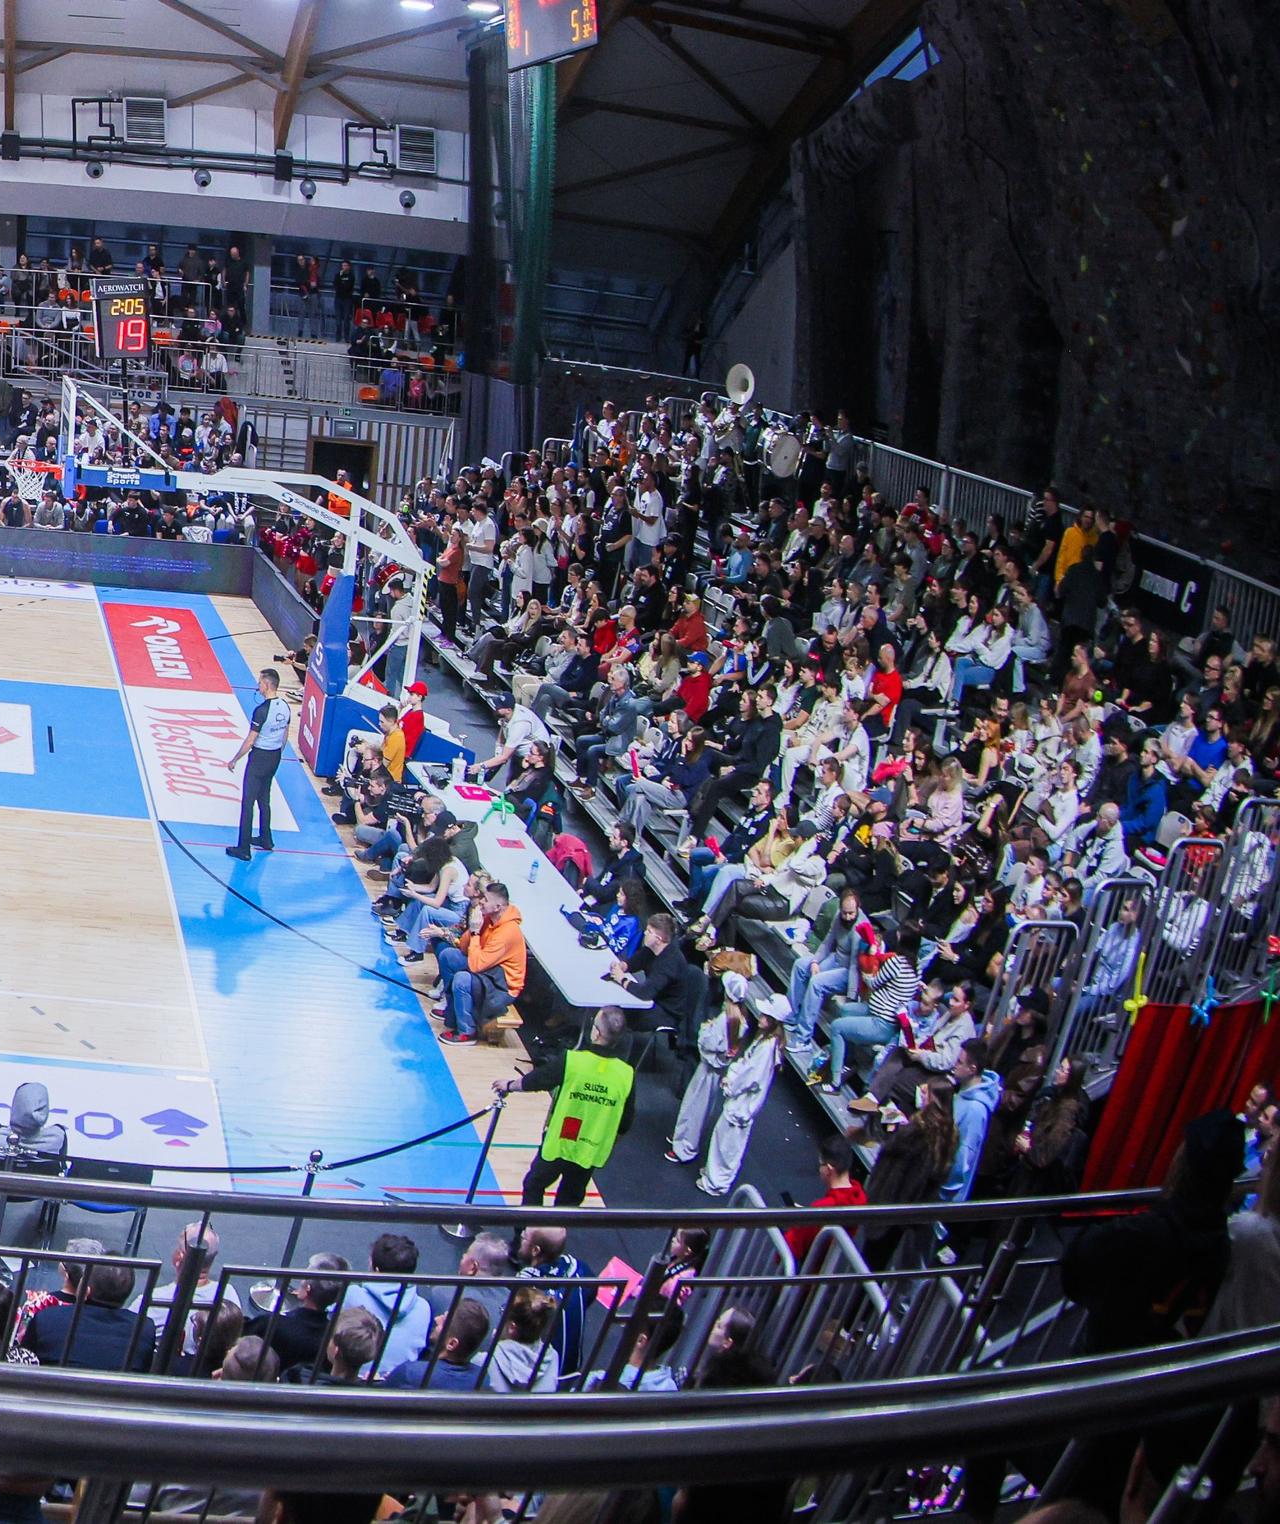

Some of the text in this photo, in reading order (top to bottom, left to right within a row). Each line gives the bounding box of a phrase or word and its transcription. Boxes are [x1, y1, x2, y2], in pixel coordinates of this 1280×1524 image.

[97, 284, 144, 293] AEROWATCH
[111, 298, 144, 316] 2:05
[118, 320, 145, 351] 19
[1181, 580, 1197, 613] C
[143, 635, 193, 680] ORLEN
